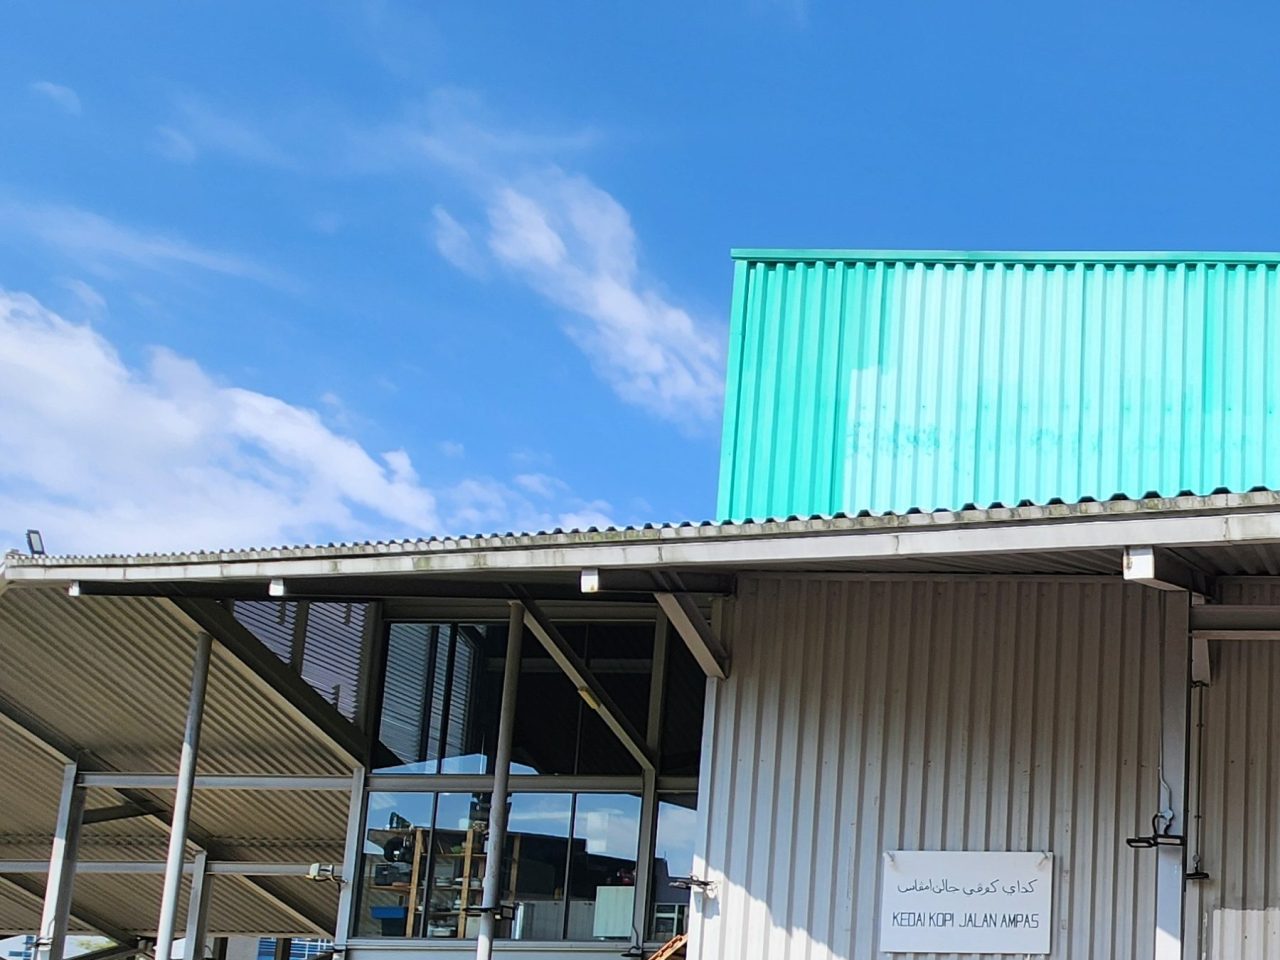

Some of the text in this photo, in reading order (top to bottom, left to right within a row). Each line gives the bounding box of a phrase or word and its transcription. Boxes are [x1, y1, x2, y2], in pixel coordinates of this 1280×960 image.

[892, 912, 1039, 928] KEDAI KOPI JALAN AMPAS
